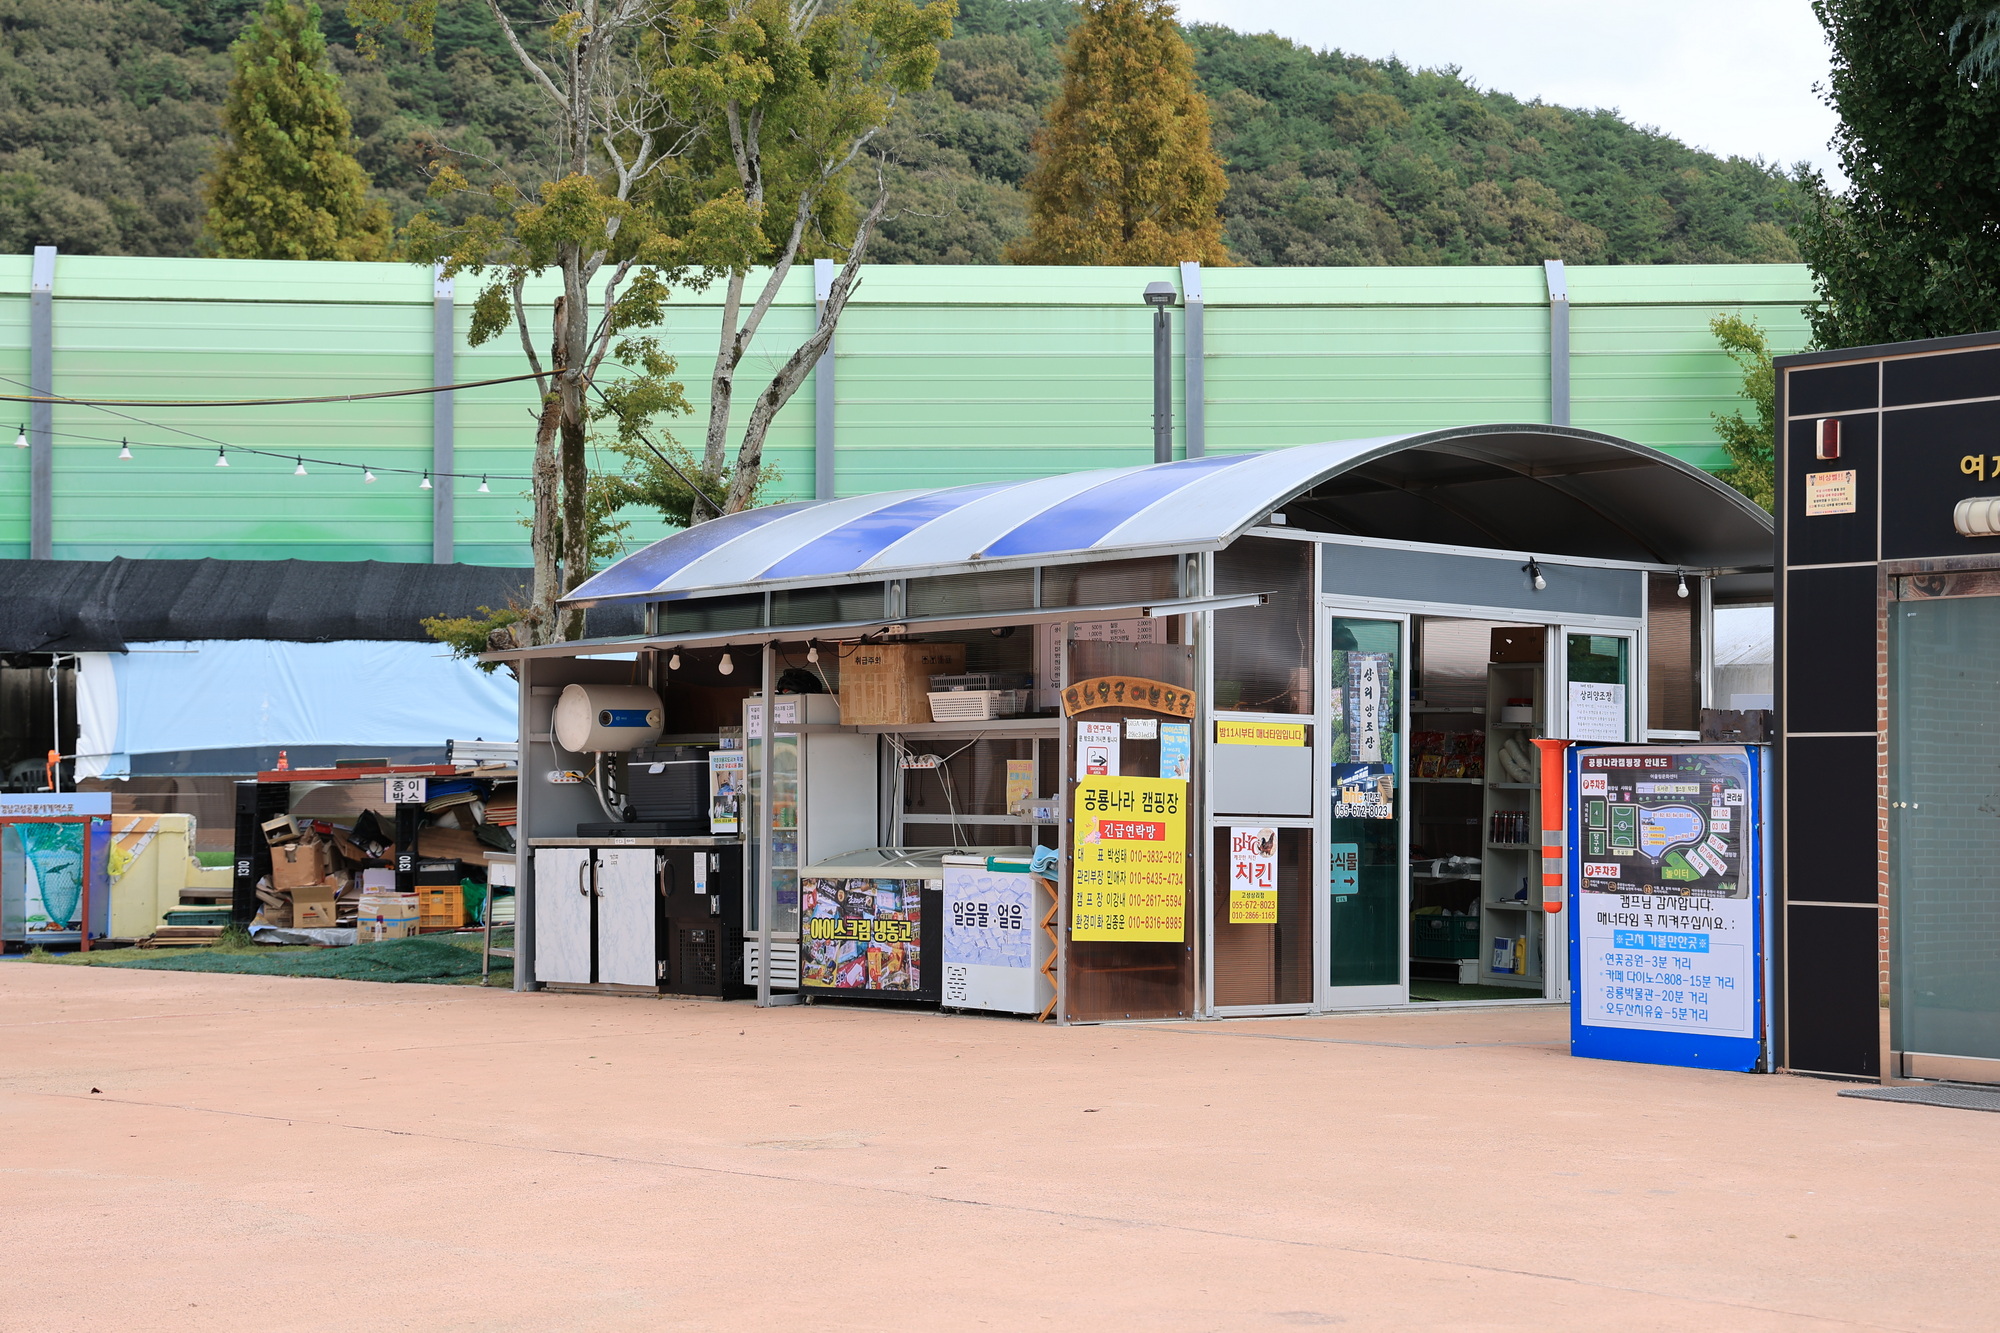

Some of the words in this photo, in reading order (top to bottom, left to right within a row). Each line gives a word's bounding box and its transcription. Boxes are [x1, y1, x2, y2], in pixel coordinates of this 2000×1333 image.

[1580, 690, 1612, 702] 상리양조장
[1364, 668, 1375, 749] 상리양조장
[1087, 724, 1112, 734] 흡연구역
[1219, 727, 1255, 739] 밤11시부터
[1256, 728, 1304, 741] 매너타임입니다.
[1588, 758, 1641, 768] 공룡나라캠핑장
[1645, 758, 1667, 767] 안내도
[1590, 780, 1605, 790] 주차장
[1084, 789, 1135, 812] 공룡나라
[1142, 791, 1179, 814] 캠핑장
[1363, 792, 1381, 802] 치킨집
[1727, 793, 1742, 802] 관리실
[1, 803, 74, 814] 경남고성공룡세계엑스포
[1334, 805, 1388, 817] 055-672-8023
[1104, 822, 1156, 839] 긴급연락망
[399, 855, 411, 872] 1310
[1130, 849, 1182, 864] 010-3832-9121
[238, 860, 250, 877] 1310
[1235, 862, 1273, 888] 치킨
[1594, 865, 1618, 877] 주차장
[1665, 869, 1689, 879] 놀이터
[1077, 869, 1104, 885] 관리부장
[1130, 871, 1183, 886] 010-6435-4734
[1129, 893, 1182, 907] 010-2617-5594
[1232, 901, 1275, 910] 055-672-8023
[1620, 895, 1651, 909] 캠프님
[1656, 896, 1714, 911] 감사합니다.
[998, 903, 1022, 930] 얼음
[1076, 914, 1103, 930] 환경미화
[1106, 914, 1125, 930] 김종운
[1128, 916, 1182, 929] 010-8316-8985
[1232, 911, 1275, 920] 010-2866-1165
[1597, 912, 1639, 926] 매너타임
[1643, 914, 1653, 926] 꼭
[1657, 914, 1727, 930] 지켜주십시요.
[810, 918, 871, 941] 아이스크림
[874, 920, 912, 942] 냉동고
[1605, 953, 1667, 968] 연꽃공원-3분
[1672, 956, 1691, 970] 거리
[1605, 969, 1624, 983] 카페
[1627, 970, 1711, 989] 다이노스808-15분
[1715, 976, 1735, 990] 거리
[1605, 986, 1684, 1003] 공룡박물관-20분
[1688, 991, 1708, 1005] 거리
